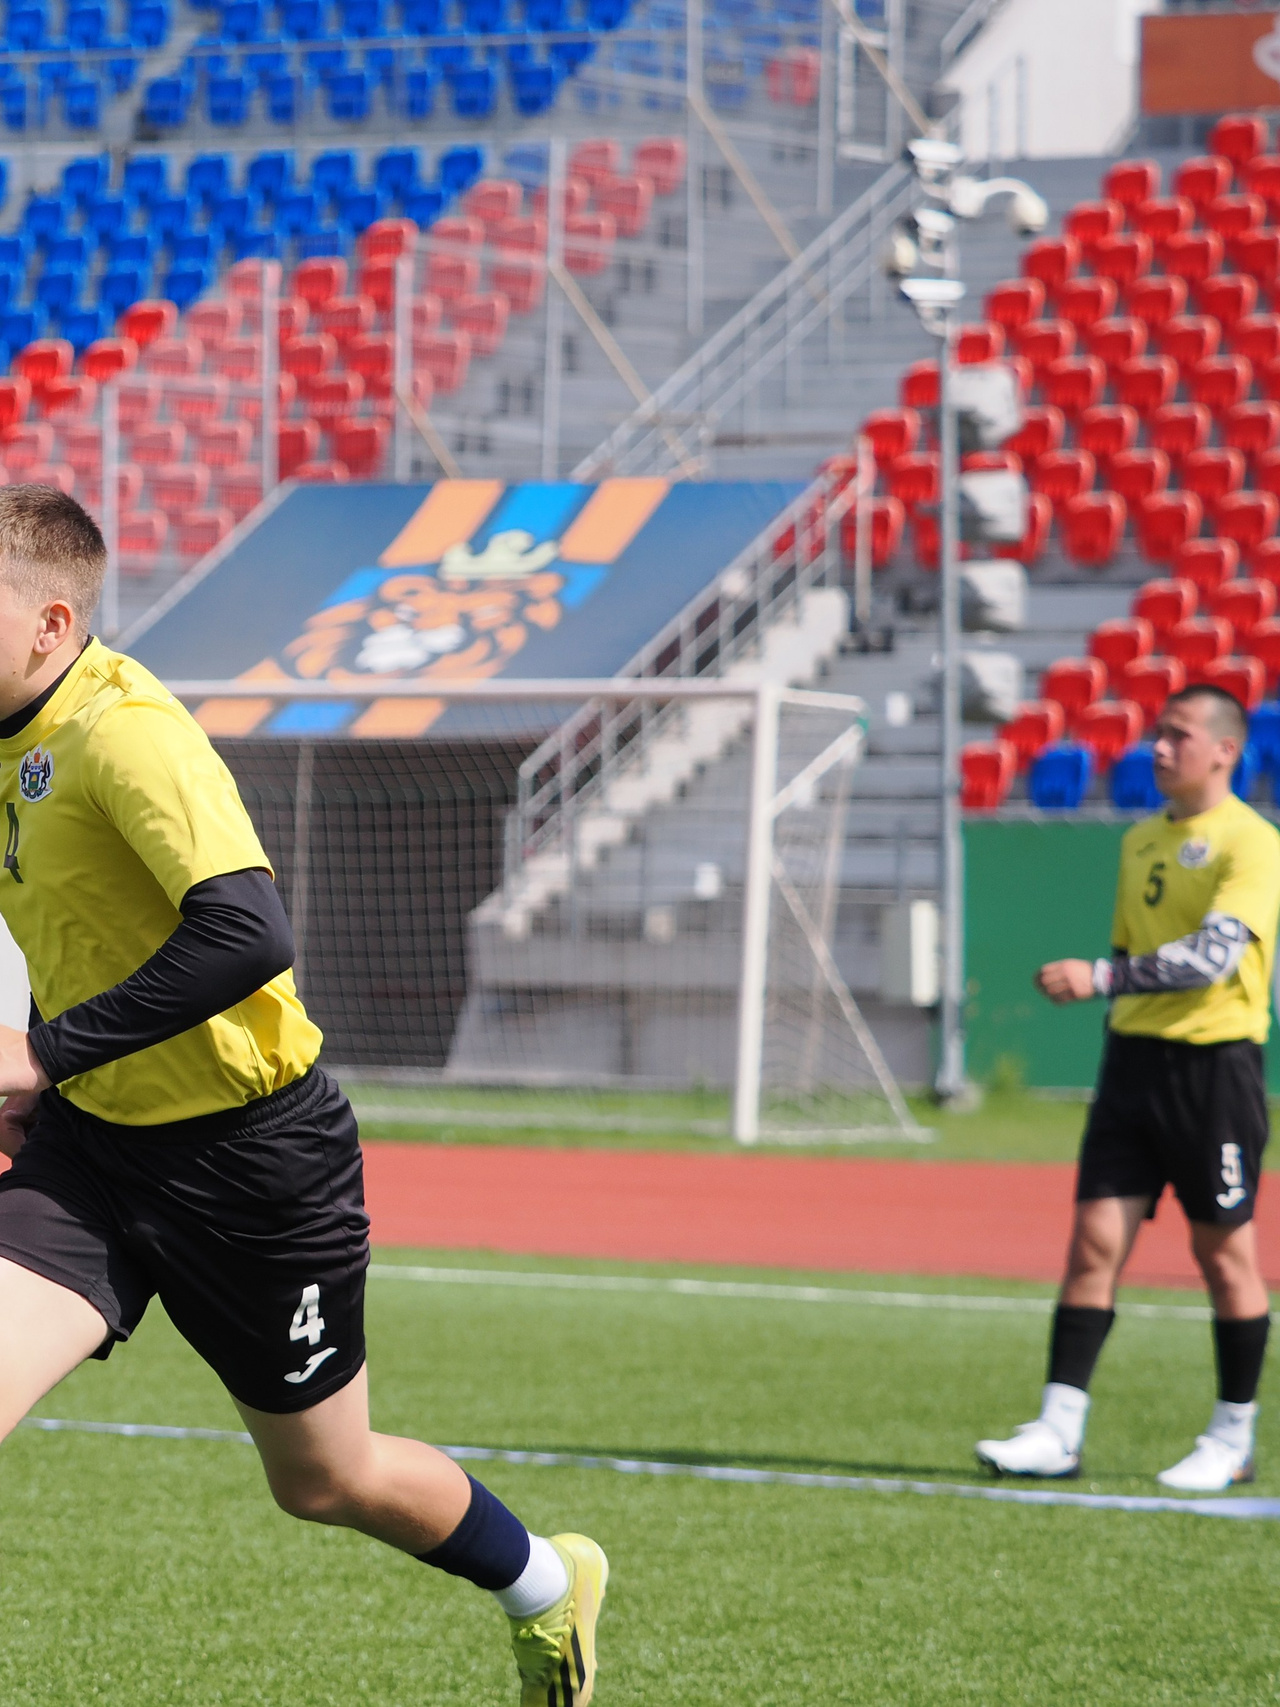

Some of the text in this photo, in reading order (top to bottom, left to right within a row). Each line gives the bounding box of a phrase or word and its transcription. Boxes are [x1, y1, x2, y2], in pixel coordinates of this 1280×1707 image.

[1144, 862, 1166, 907] 5
[1221, 1142, 1243, 1188] 5
[289, 1283, 326, 1346] 4
